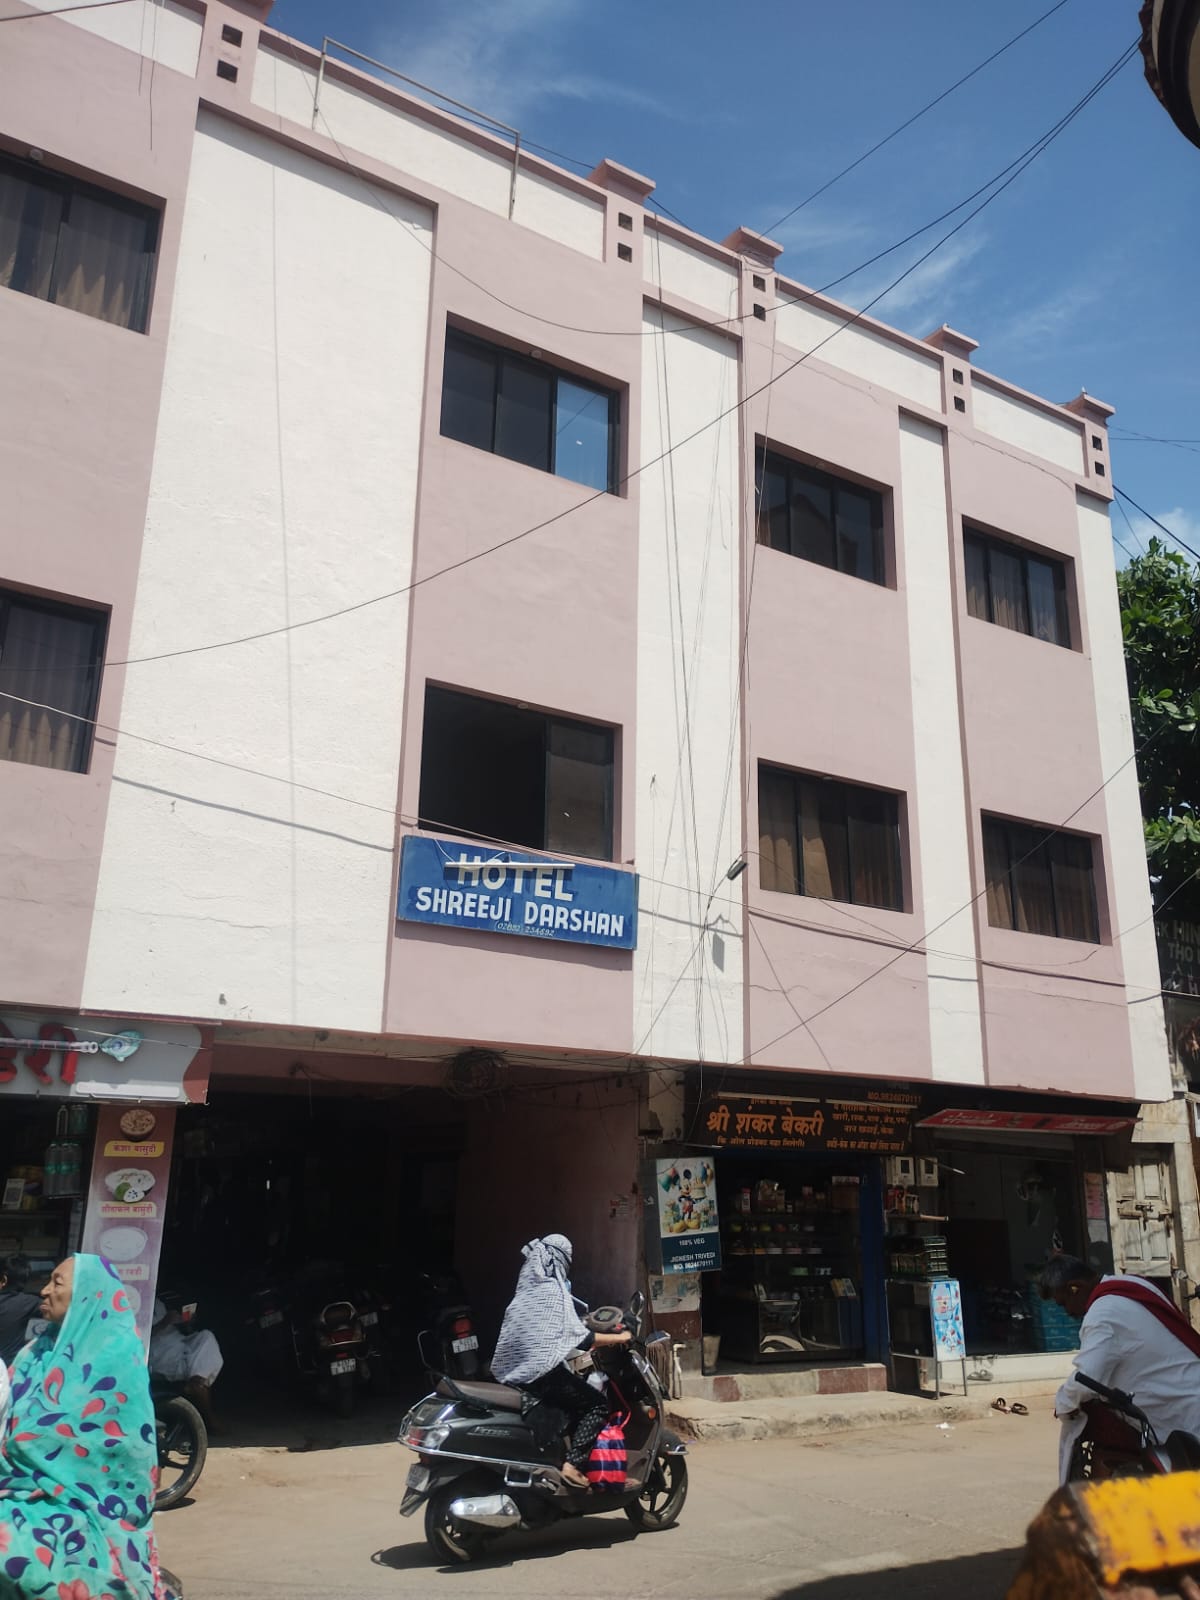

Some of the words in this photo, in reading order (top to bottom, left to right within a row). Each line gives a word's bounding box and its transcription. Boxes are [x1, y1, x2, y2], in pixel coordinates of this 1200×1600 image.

[457, 852, 574, 902] HOTEL
[415, 886, 512, 922] SHREEJI
[523, 901, 625, 938] DARSHAN
[707, 1104, 731, 1132] श्री
[736, 1104, 777, 1134] शंकर
[781, 1106, 825, 1136] बेकरी
